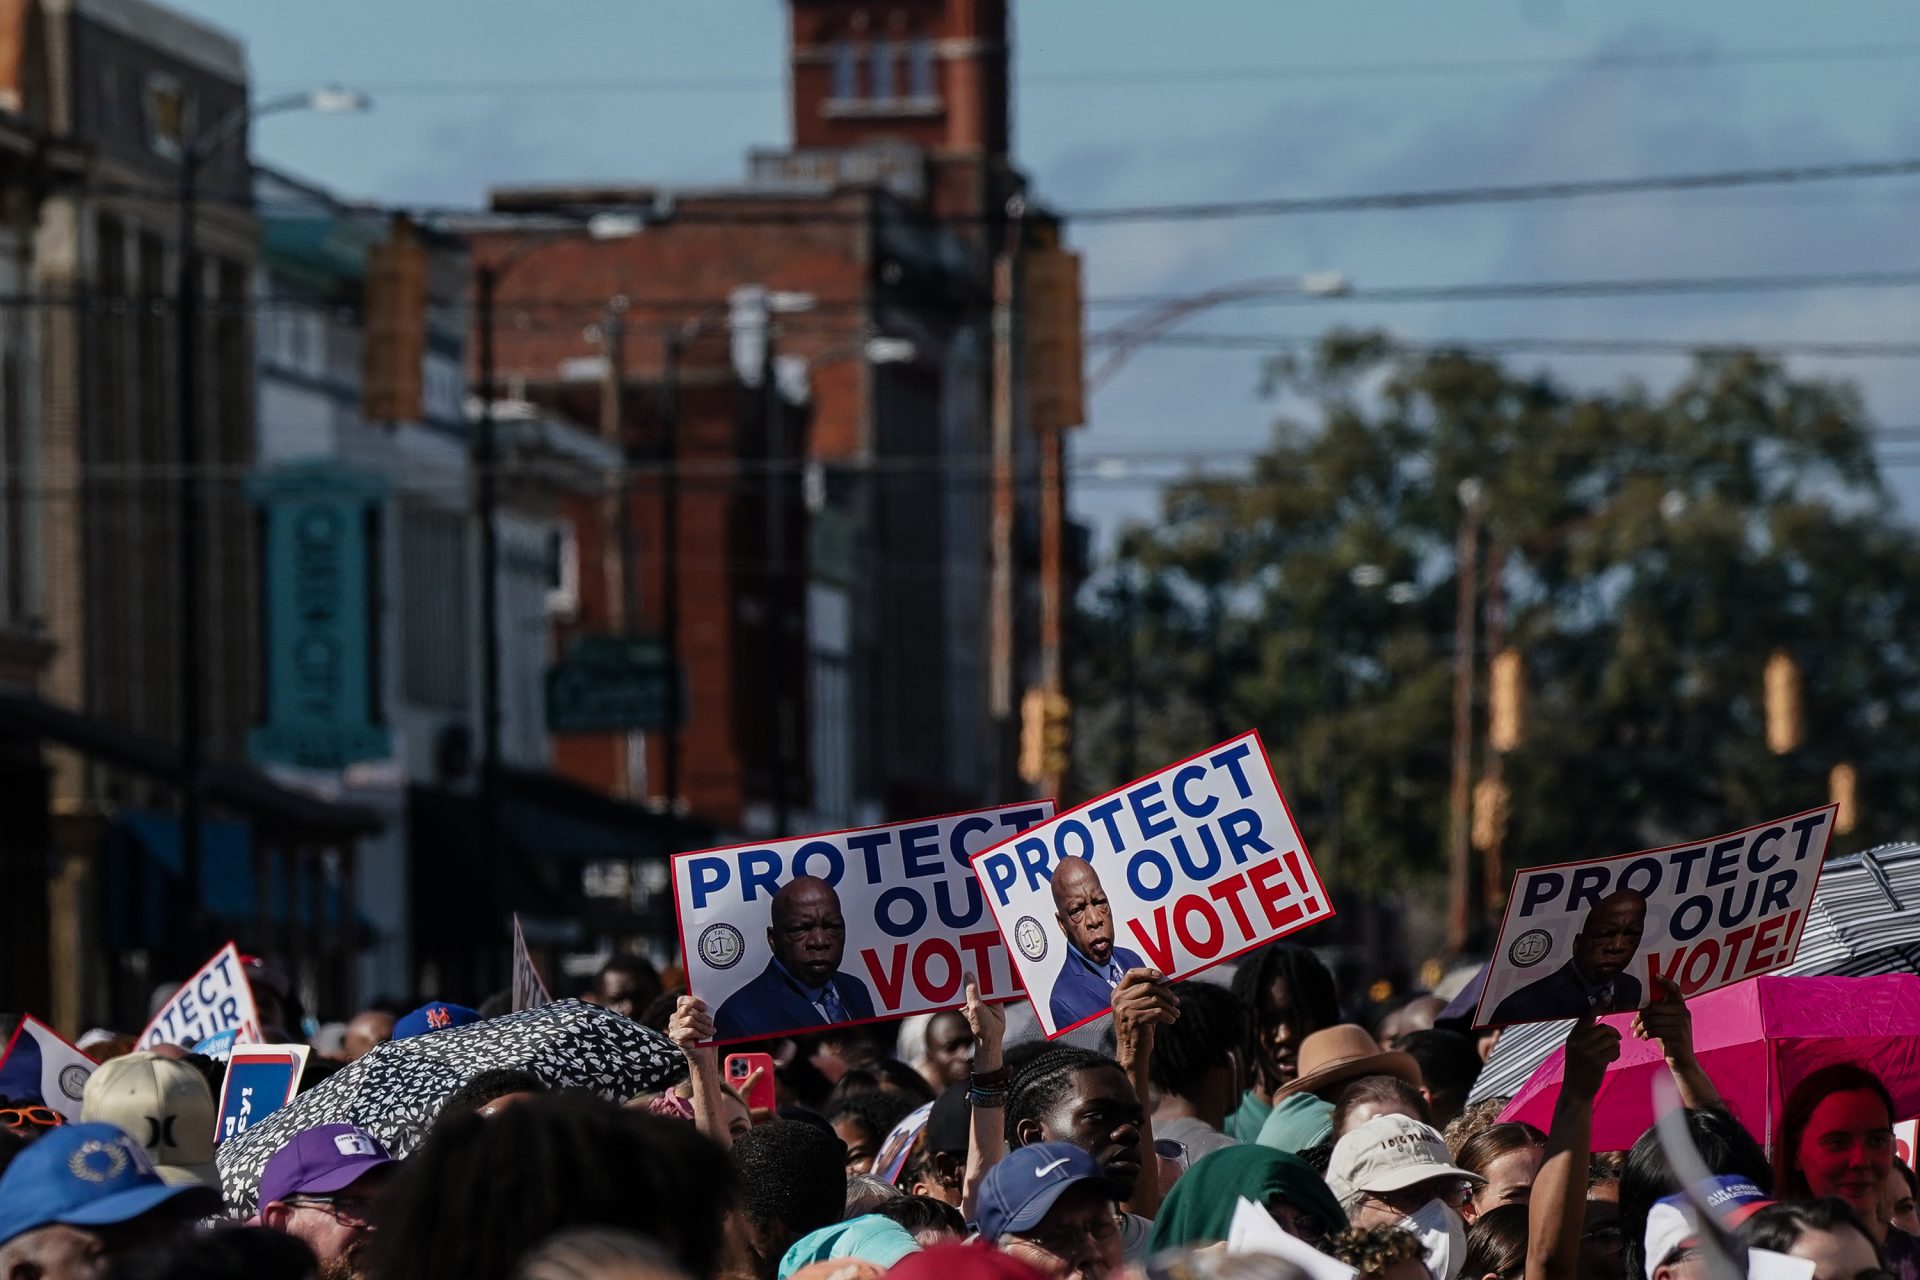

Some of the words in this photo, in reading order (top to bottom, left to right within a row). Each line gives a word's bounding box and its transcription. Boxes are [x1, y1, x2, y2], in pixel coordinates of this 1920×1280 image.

[688, 808, 1044, 909] PROTECT
[984, 743, 1253, 906] PROTECT
[1127, 808, 1275, 901] OUR
[1519, 813, 1826, 917] PROTECT
[874, 876, 984, 937] OU
[1127, 850, 1320, 977] VOTE!
[1669, 869, 1798, 941] OUR
[149, 954, 231, 1042] OTECT
[861, 930, 1028, 1011] VOT
[1648, 909, 1801, 1002] VOTE!
[1388, 1136, 1407, 1147] DIG
